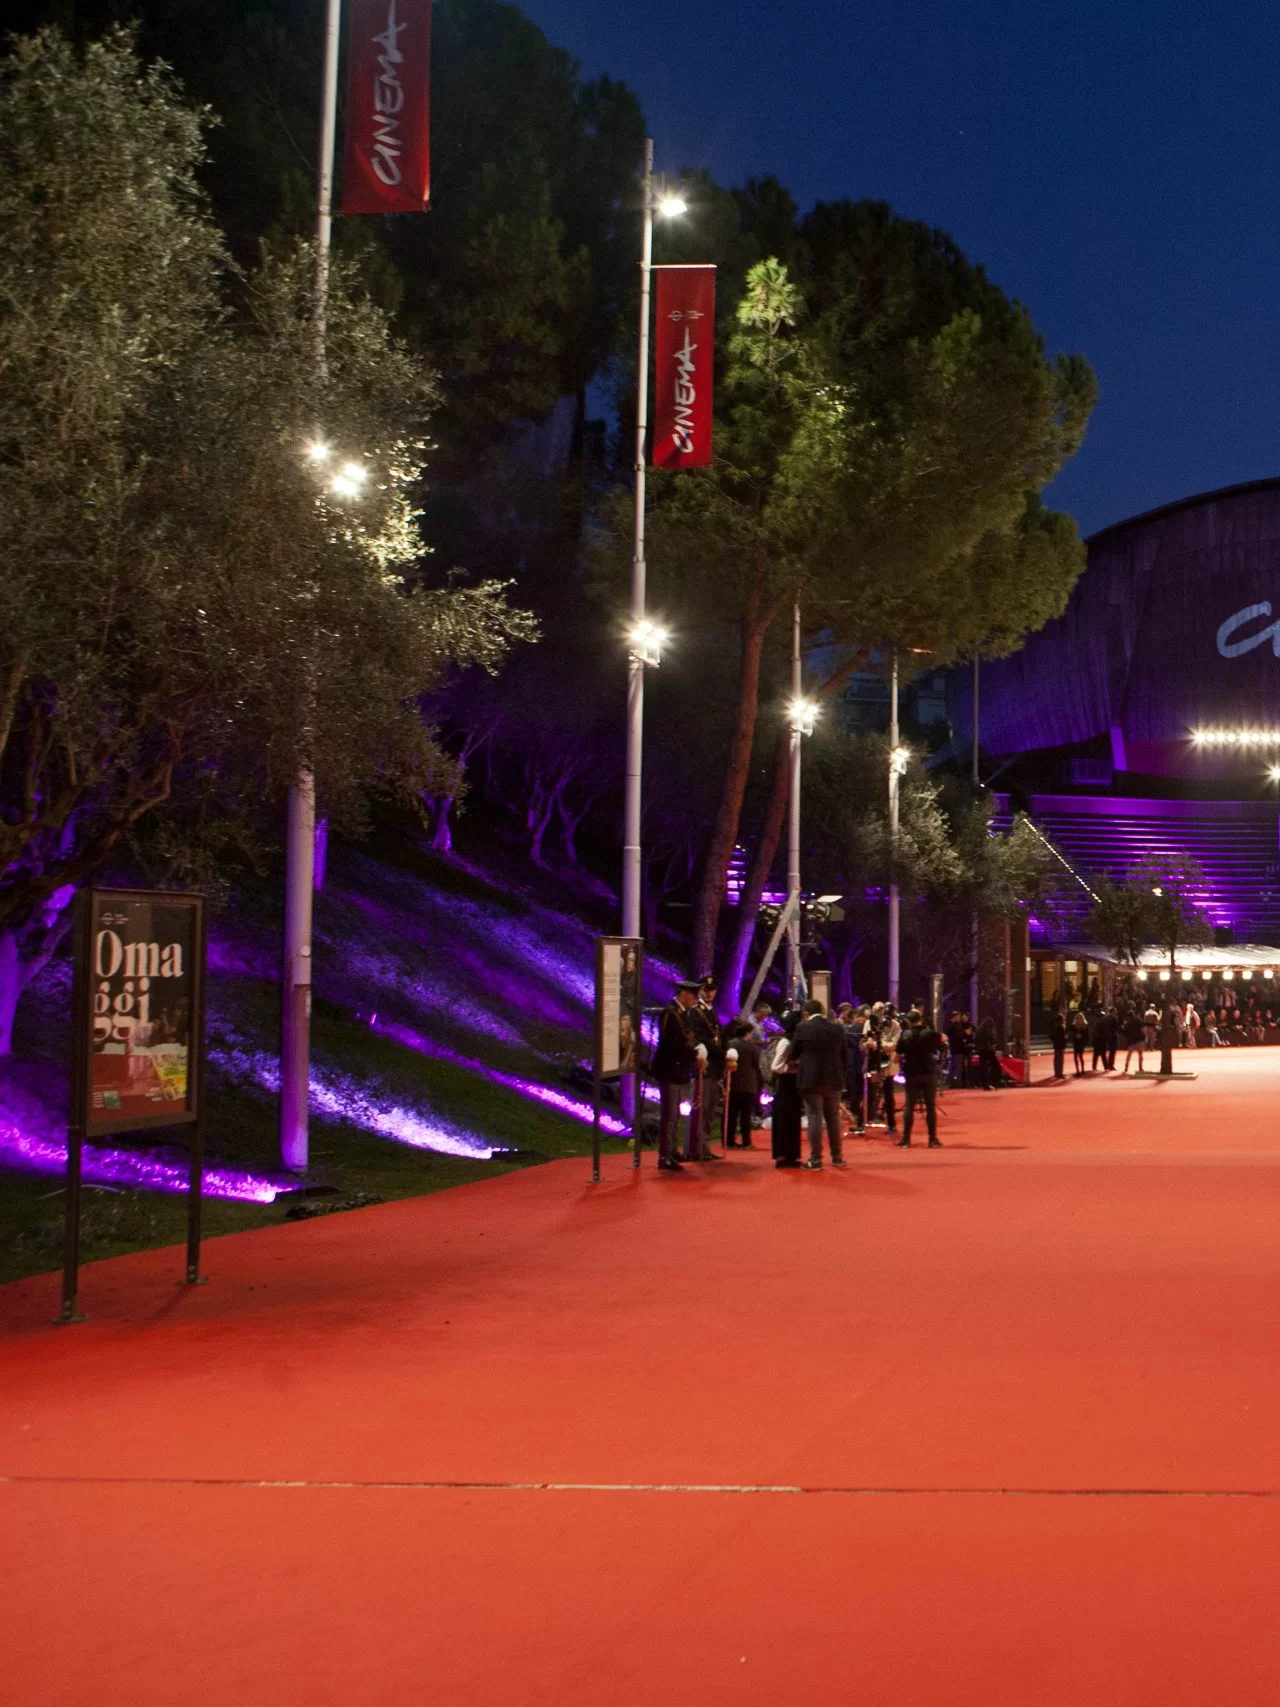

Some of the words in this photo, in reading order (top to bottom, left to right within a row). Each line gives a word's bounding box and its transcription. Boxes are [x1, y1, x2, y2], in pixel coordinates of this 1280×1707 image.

[371, 0, 408, 185] CINEMA
[672, 325, 698, 453] CINEMA
[95, 929, 184, 978] Oma
